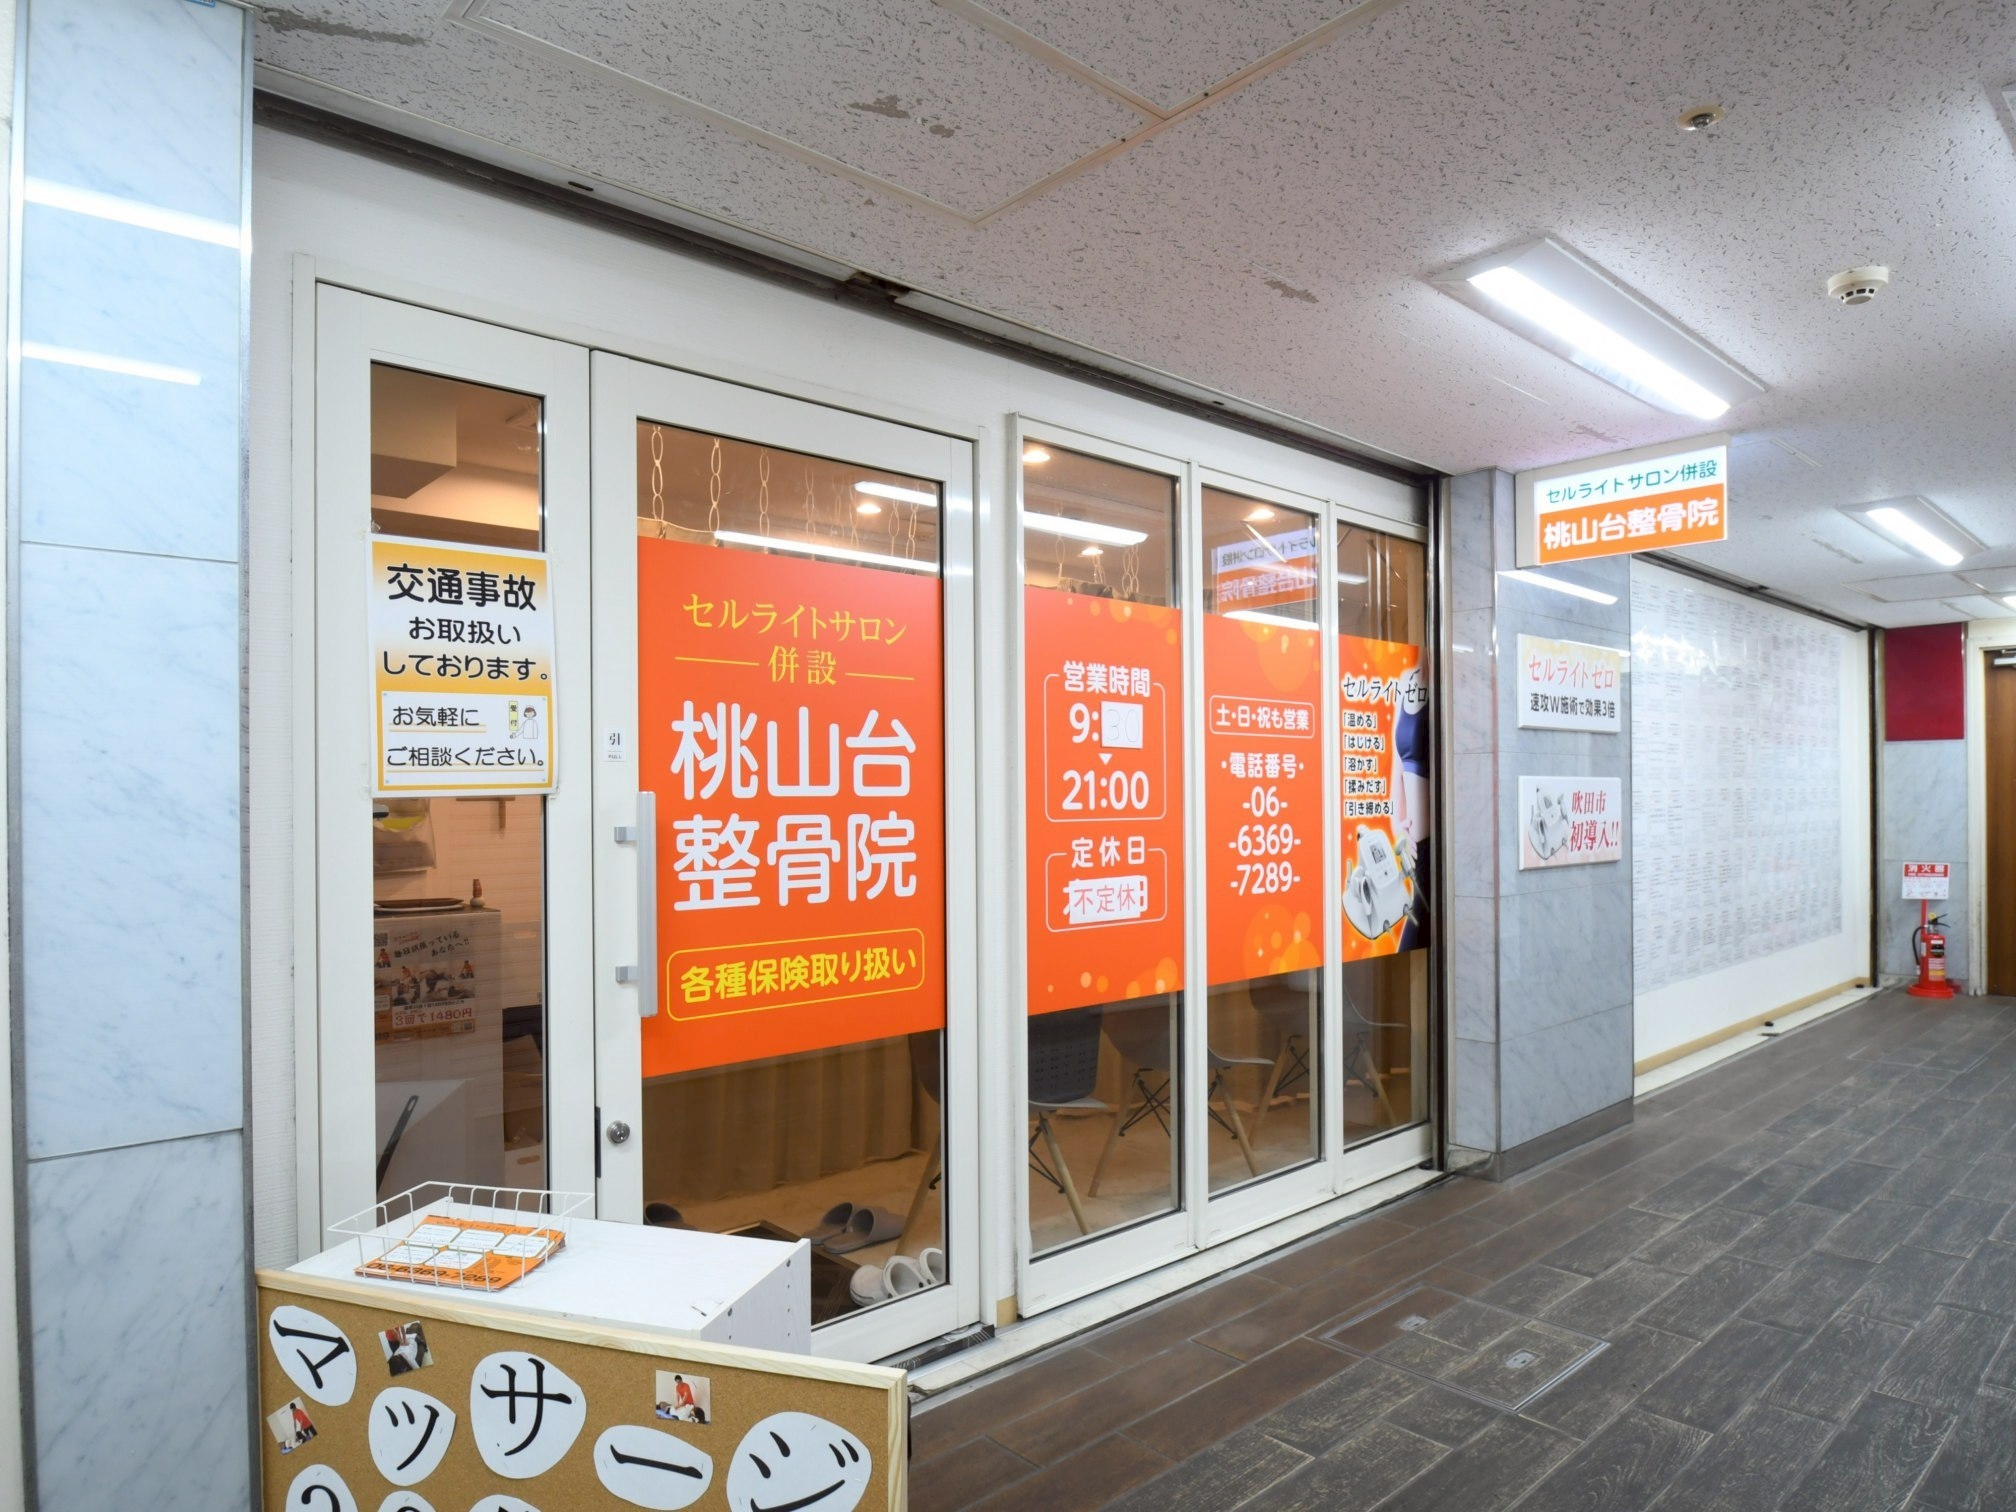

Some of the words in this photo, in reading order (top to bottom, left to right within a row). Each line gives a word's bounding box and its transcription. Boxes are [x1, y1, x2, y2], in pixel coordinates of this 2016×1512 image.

[1546, 459, 1717, 504] セルライトサロン併設
[1543, 497, 1719, 550] 桃山台整骨院
[387, 563, 537, 611] 交通事故
[409, 617, 521, 644] お取扱い
[683, 594, 907, 645] セルライトサロン
[383, 651, 549, 681] しております。
[768, 645, 837, 685] 併設
[1063, 660, 1150, 698] 営業時間
[1343, 676, 1428, 703] セルライトゼロ
[392, 706, 480, 727] お気軽に
[387, 747, 544, 767] ご相談ください。
[608, 732, 621, 746] 引
[671, 700, 916, 800] 桃山台
[1062, 769, 1149, 810] 21:00
[1572, 790, 1606, 815] 吹田市
[673, 811, 916, 911] 整骨院
[1072, 836, 1145, 868] 定休日
[1074, 884, 1136, 915] 不定休
[681, 947, 916, 1003] 各種保険取り扱い
